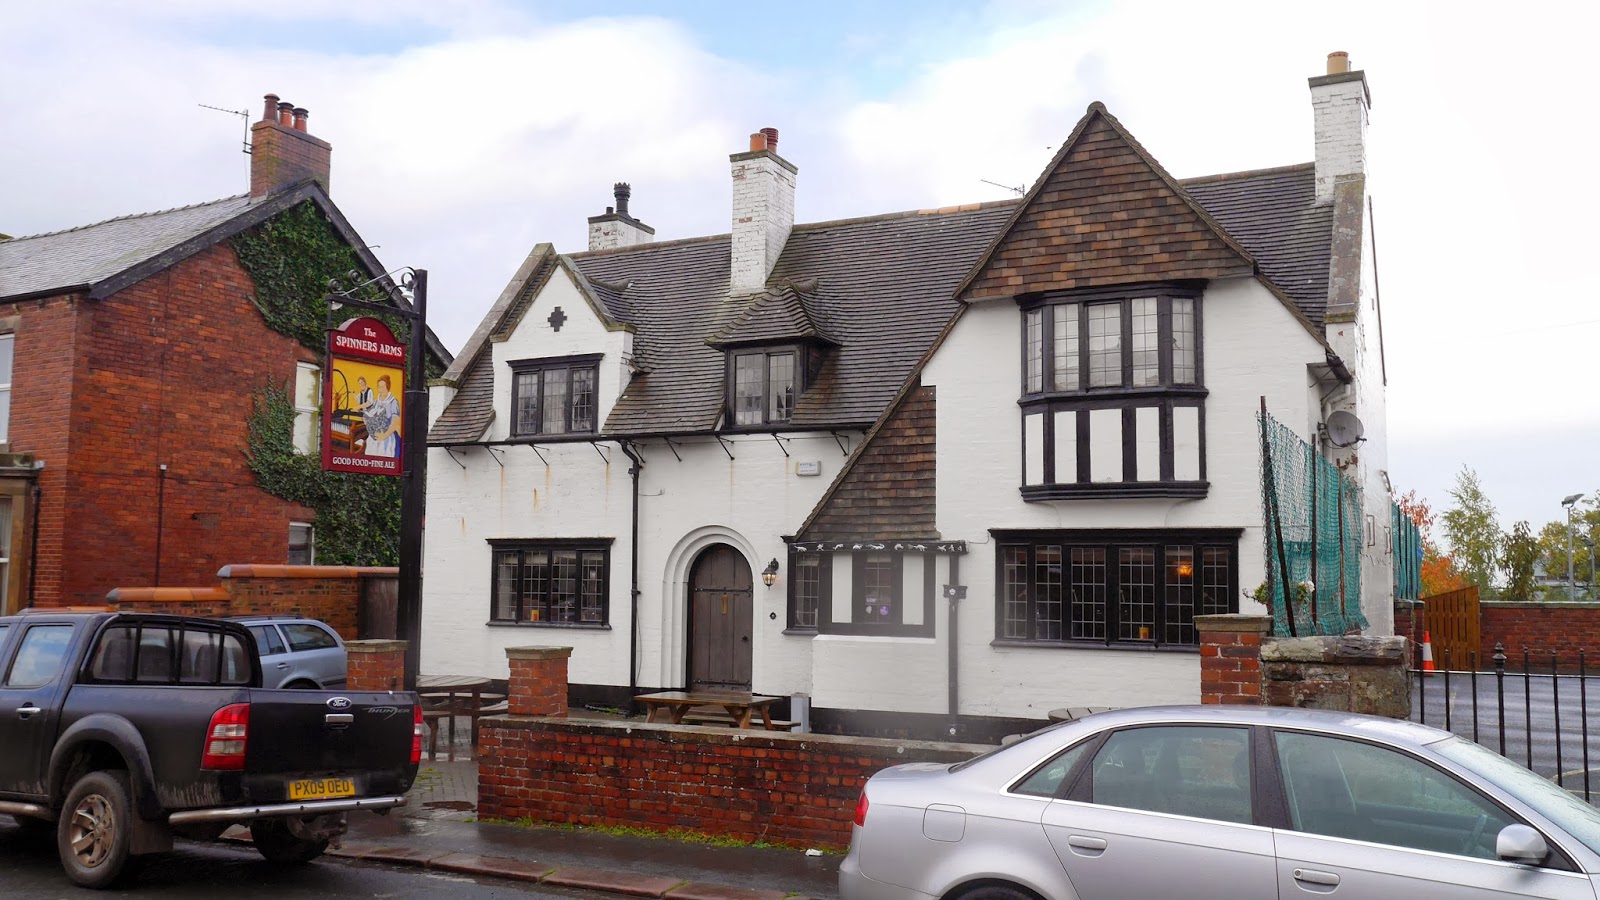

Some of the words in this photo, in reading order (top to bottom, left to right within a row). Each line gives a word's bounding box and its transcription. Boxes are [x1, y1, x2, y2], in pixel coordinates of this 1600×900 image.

[363, 327, 377, 338] The
[336, 335, 378, 353] SPINNERS
[379, 343, 403, 357] ARMS
[332, 456, 351, 466] GOOD
[384, 461, 396, 469] ALE
[332, 699, 347, 707] Ford
[295, 780, 326, 796] PX09
